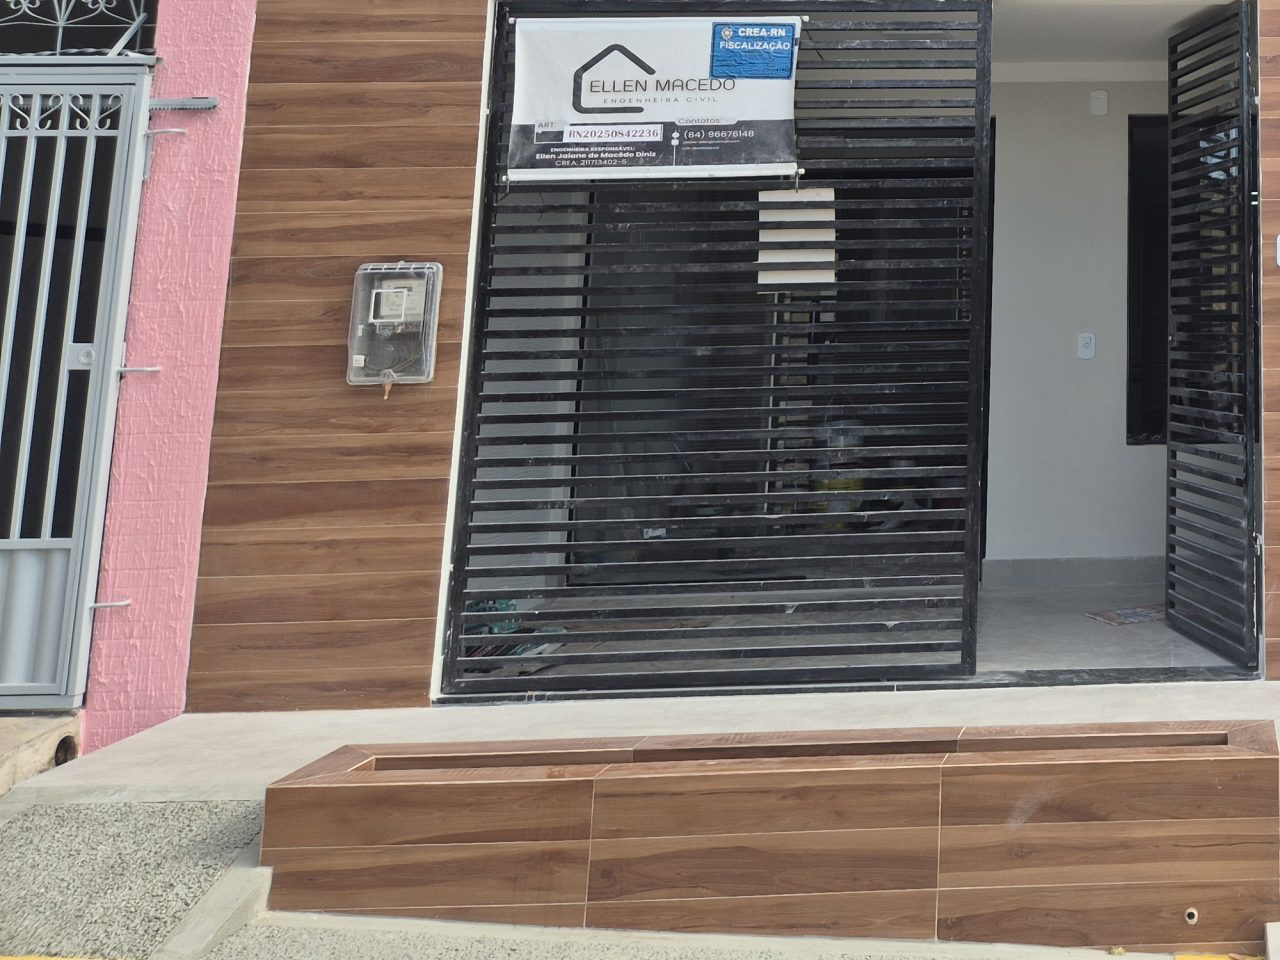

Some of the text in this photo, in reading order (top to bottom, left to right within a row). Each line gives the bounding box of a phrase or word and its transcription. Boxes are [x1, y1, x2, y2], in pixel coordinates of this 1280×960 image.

[738, 27, 786, 37] CREA-RN
[720, 39, 791, 51] FISCALIZAÇÃO
[590, 78, 736, 93] ELLEN MACEDO
[568, 129, 659, 139] RN20250842236
[684, 129, 705, 140] (84)
[635, 150, 657, 158] Diniz
